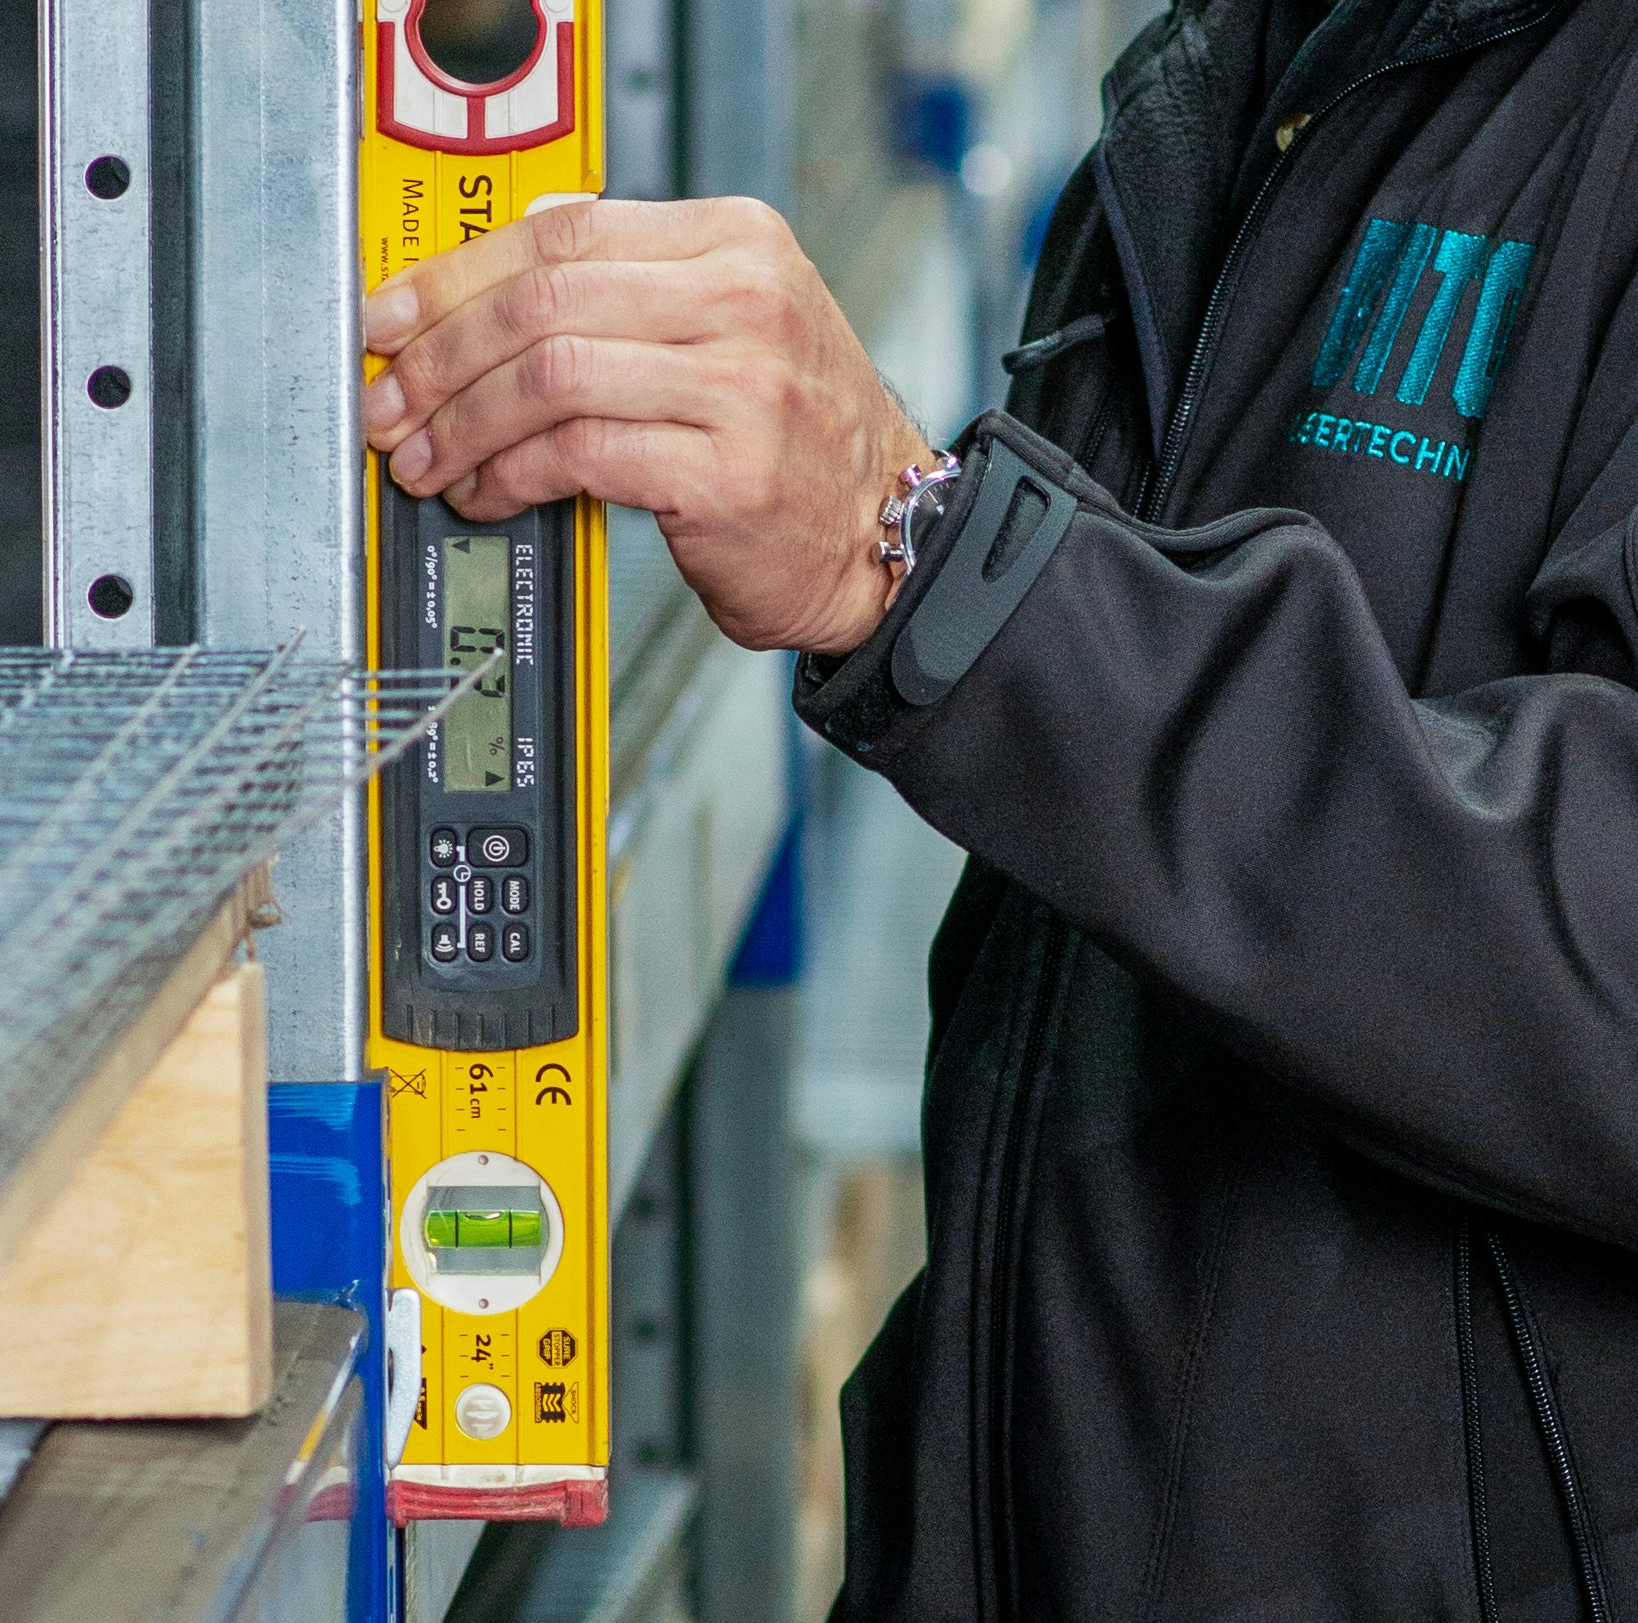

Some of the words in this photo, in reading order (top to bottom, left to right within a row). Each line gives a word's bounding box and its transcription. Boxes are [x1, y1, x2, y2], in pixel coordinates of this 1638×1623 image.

[402, 179, 424, 247] MADE
[515, 544, 534, 665] ELECTRONIC
[516, 738, 535, 787] IP65
[473, 880, 485, 911] HOLD
[509, 880, 521, 911] MODE
[474, 933, 485, 953] REF
[510, 933, 521, 953] CAL
